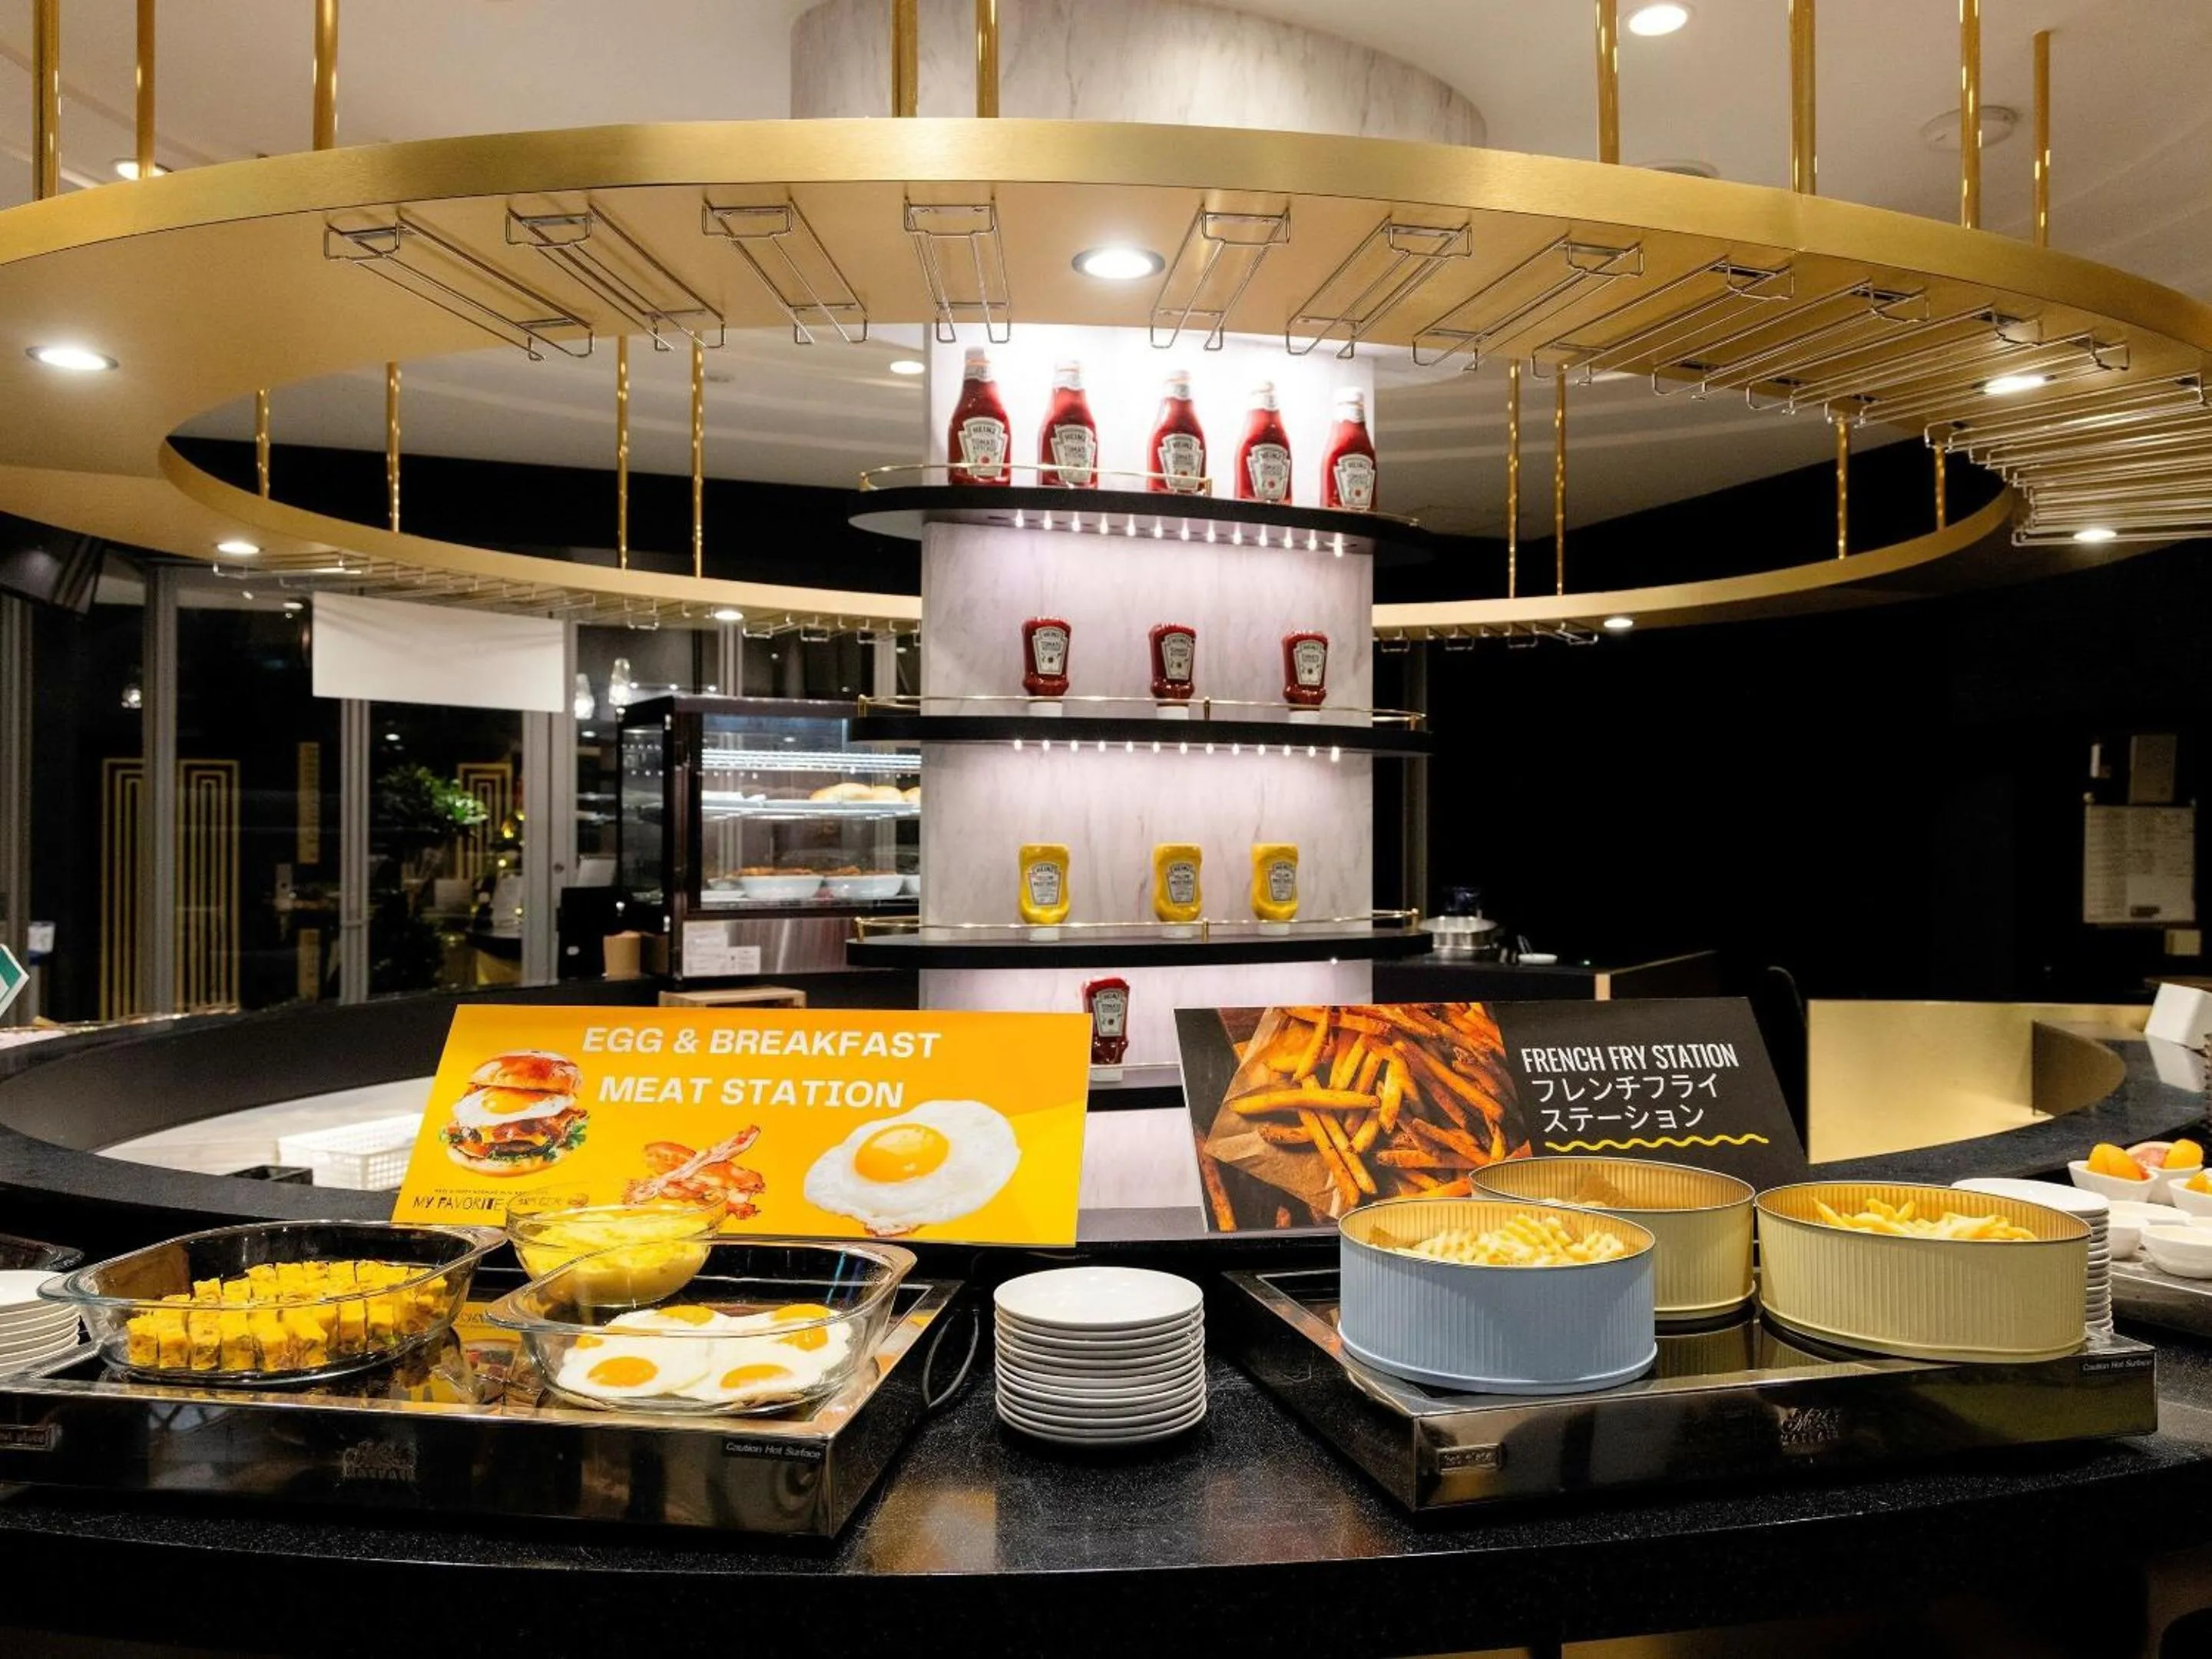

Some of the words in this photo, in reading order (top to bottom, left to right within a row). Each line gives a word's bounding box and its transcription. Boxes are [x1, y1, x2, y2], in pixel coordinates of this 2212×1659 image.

[972, 425, 997, 434] HEINZ
[584, 1028, 661, 1052] EGG
[674, 1029, 697, 1053] &
[710, 1029, 941, 1058] BREAKFAST
[1521, 1046, 1606, 1073] FRENCH
[1608, 1045, 1647, 1071] FRY
[1652, 1043, 1740, 1070] STATION
[600, 1077, 712, 1102] MEAT
[721, 1079, 904, 1108] STATION
[1532, 1073, 1718, 1103] フレンチフライ
[1541, 1104, 1704, 1134] ステーション
[412, 1196, 434, 1209] MY
[726, 1442, 763, 1454] Caution
[765, 1445, 783, 1455] Hot
[785, 1445, 821, 1459] Surface
